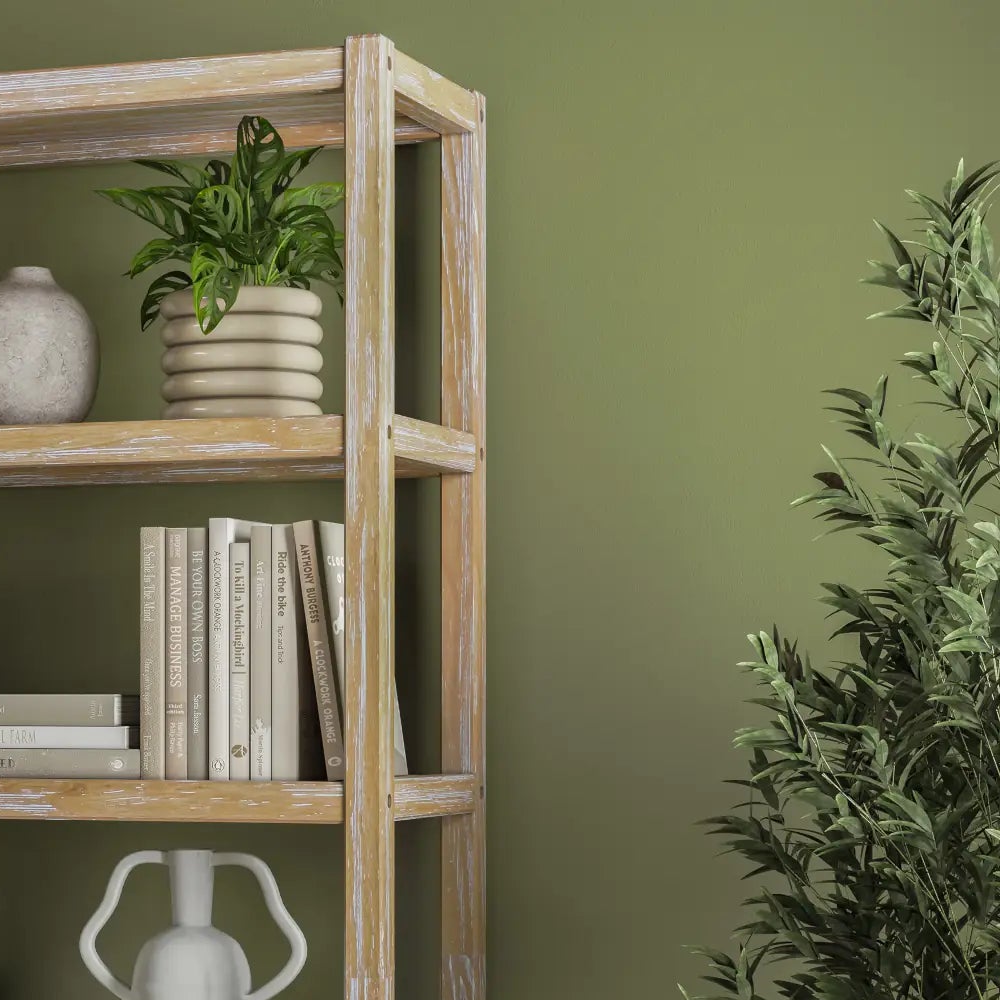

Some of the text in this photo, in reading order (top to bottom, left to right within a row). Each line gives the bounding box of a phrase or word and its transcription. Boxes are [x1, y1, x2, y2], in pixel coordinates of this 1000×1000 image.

[144, 552, 155, 573] Smile
[213, 558, 221, 601] CLOCKWORK
[235, 561, 244, 573] To
[278, 552, 287, 574] Ride
[300, 544, 314, 585] ANTHONY
[144, 585, 155, 599] The
[170, 566, 182, 622] MANAGE
[235, 576, 245, 593] Kill
[278, 577, 286, 593] the
[192, 550, 204, 663] BE YOUR OWN BOSS
[278, 596, 286, 617] bike
[306, 588, 320, 623] BURGESS
[233, 604, 245, 666] Mockingbird
[170, 625, 182, 688] BUSINESS
[315, 649, 331, 705] CLOCKWORK
[10, 730, 36, 744] FARM
[323, 708, 336, 744] ORANGE
